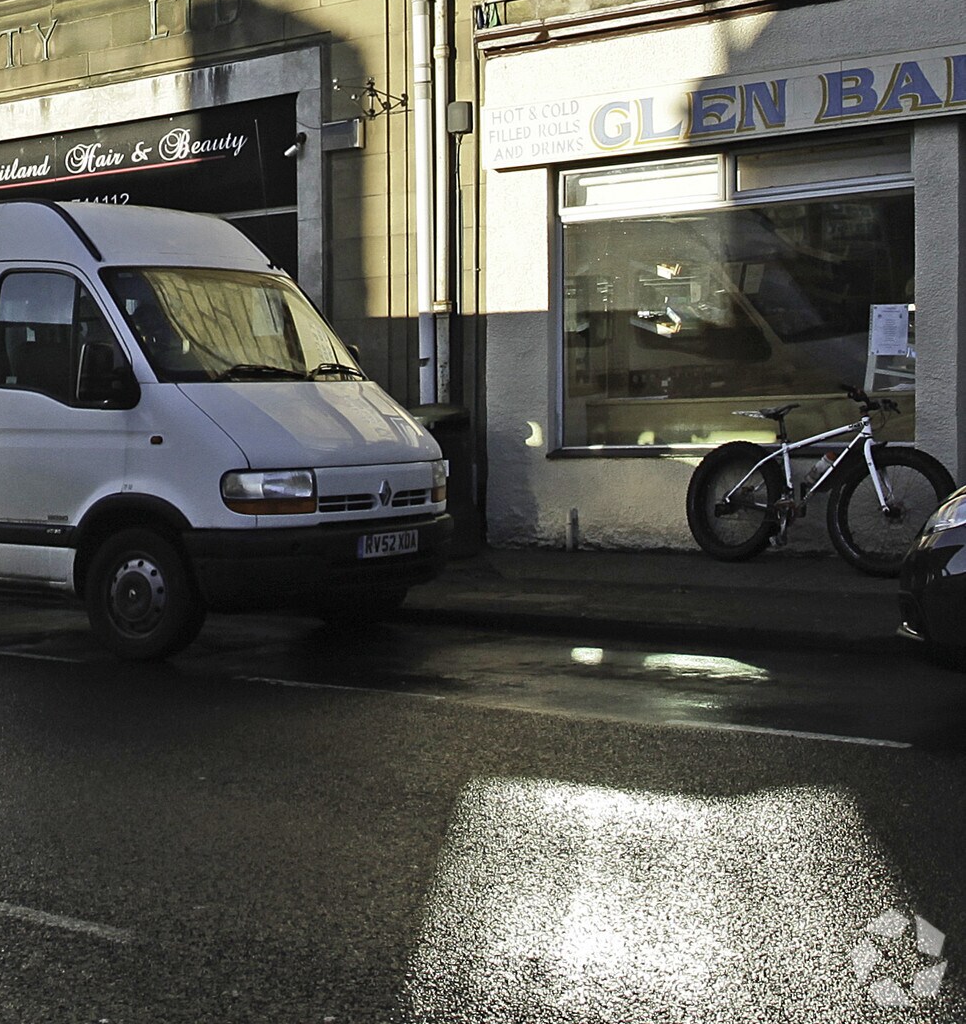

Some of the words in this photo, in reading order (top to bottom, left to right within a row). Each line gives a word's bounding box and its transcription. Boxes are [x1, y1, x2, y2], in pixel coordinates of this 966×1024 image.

[491, 107, 524, 125] HOT
[528, 106, 538, 121] &
[541, 100, 580, 119] COLD
[590, 79, 787, 151] GLEN
[489, 126, 532, 144] FILLED
[538, 119, 581, 137] ROLLS
[65, 143, 125, 174] Hair
[131, 141, 153, 163] &
[158, 128, 248, 162] Beauty
[493, 145, 523, 162] AND
[531, 137, 584, 157] DRINKS
[365, 534, 396, 554] RV52
